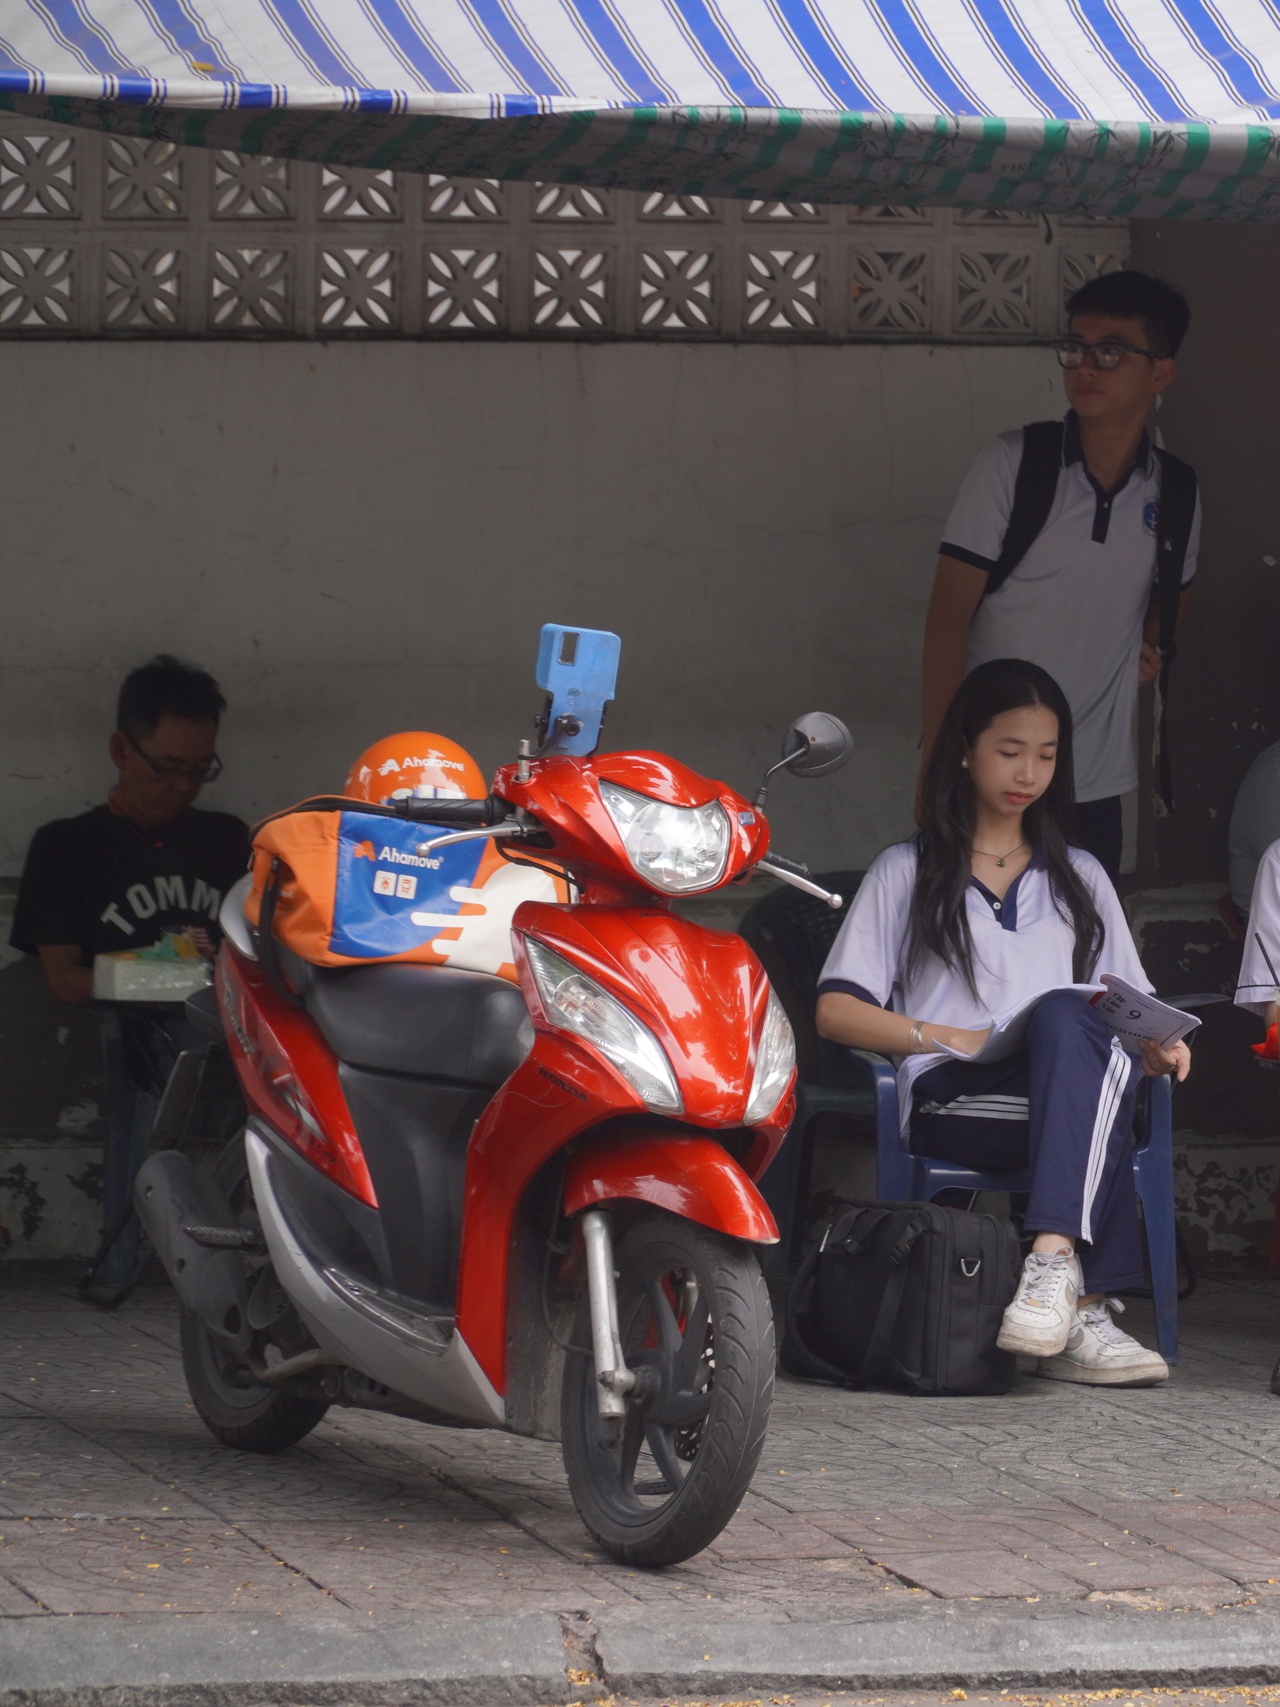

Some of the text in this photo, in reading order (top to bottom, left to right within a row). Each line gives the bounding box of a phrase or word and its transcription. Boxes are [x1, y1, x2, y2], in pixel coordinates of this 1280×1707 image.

[402, 755, 464, 772] Ahamove
[377, 845, 441, 871] Ahamove
[99, 875, 222, 937] TOMM
[1126, 1009, 1142, 1020] 9
[537, 1064, 588, 1105] HONDA
